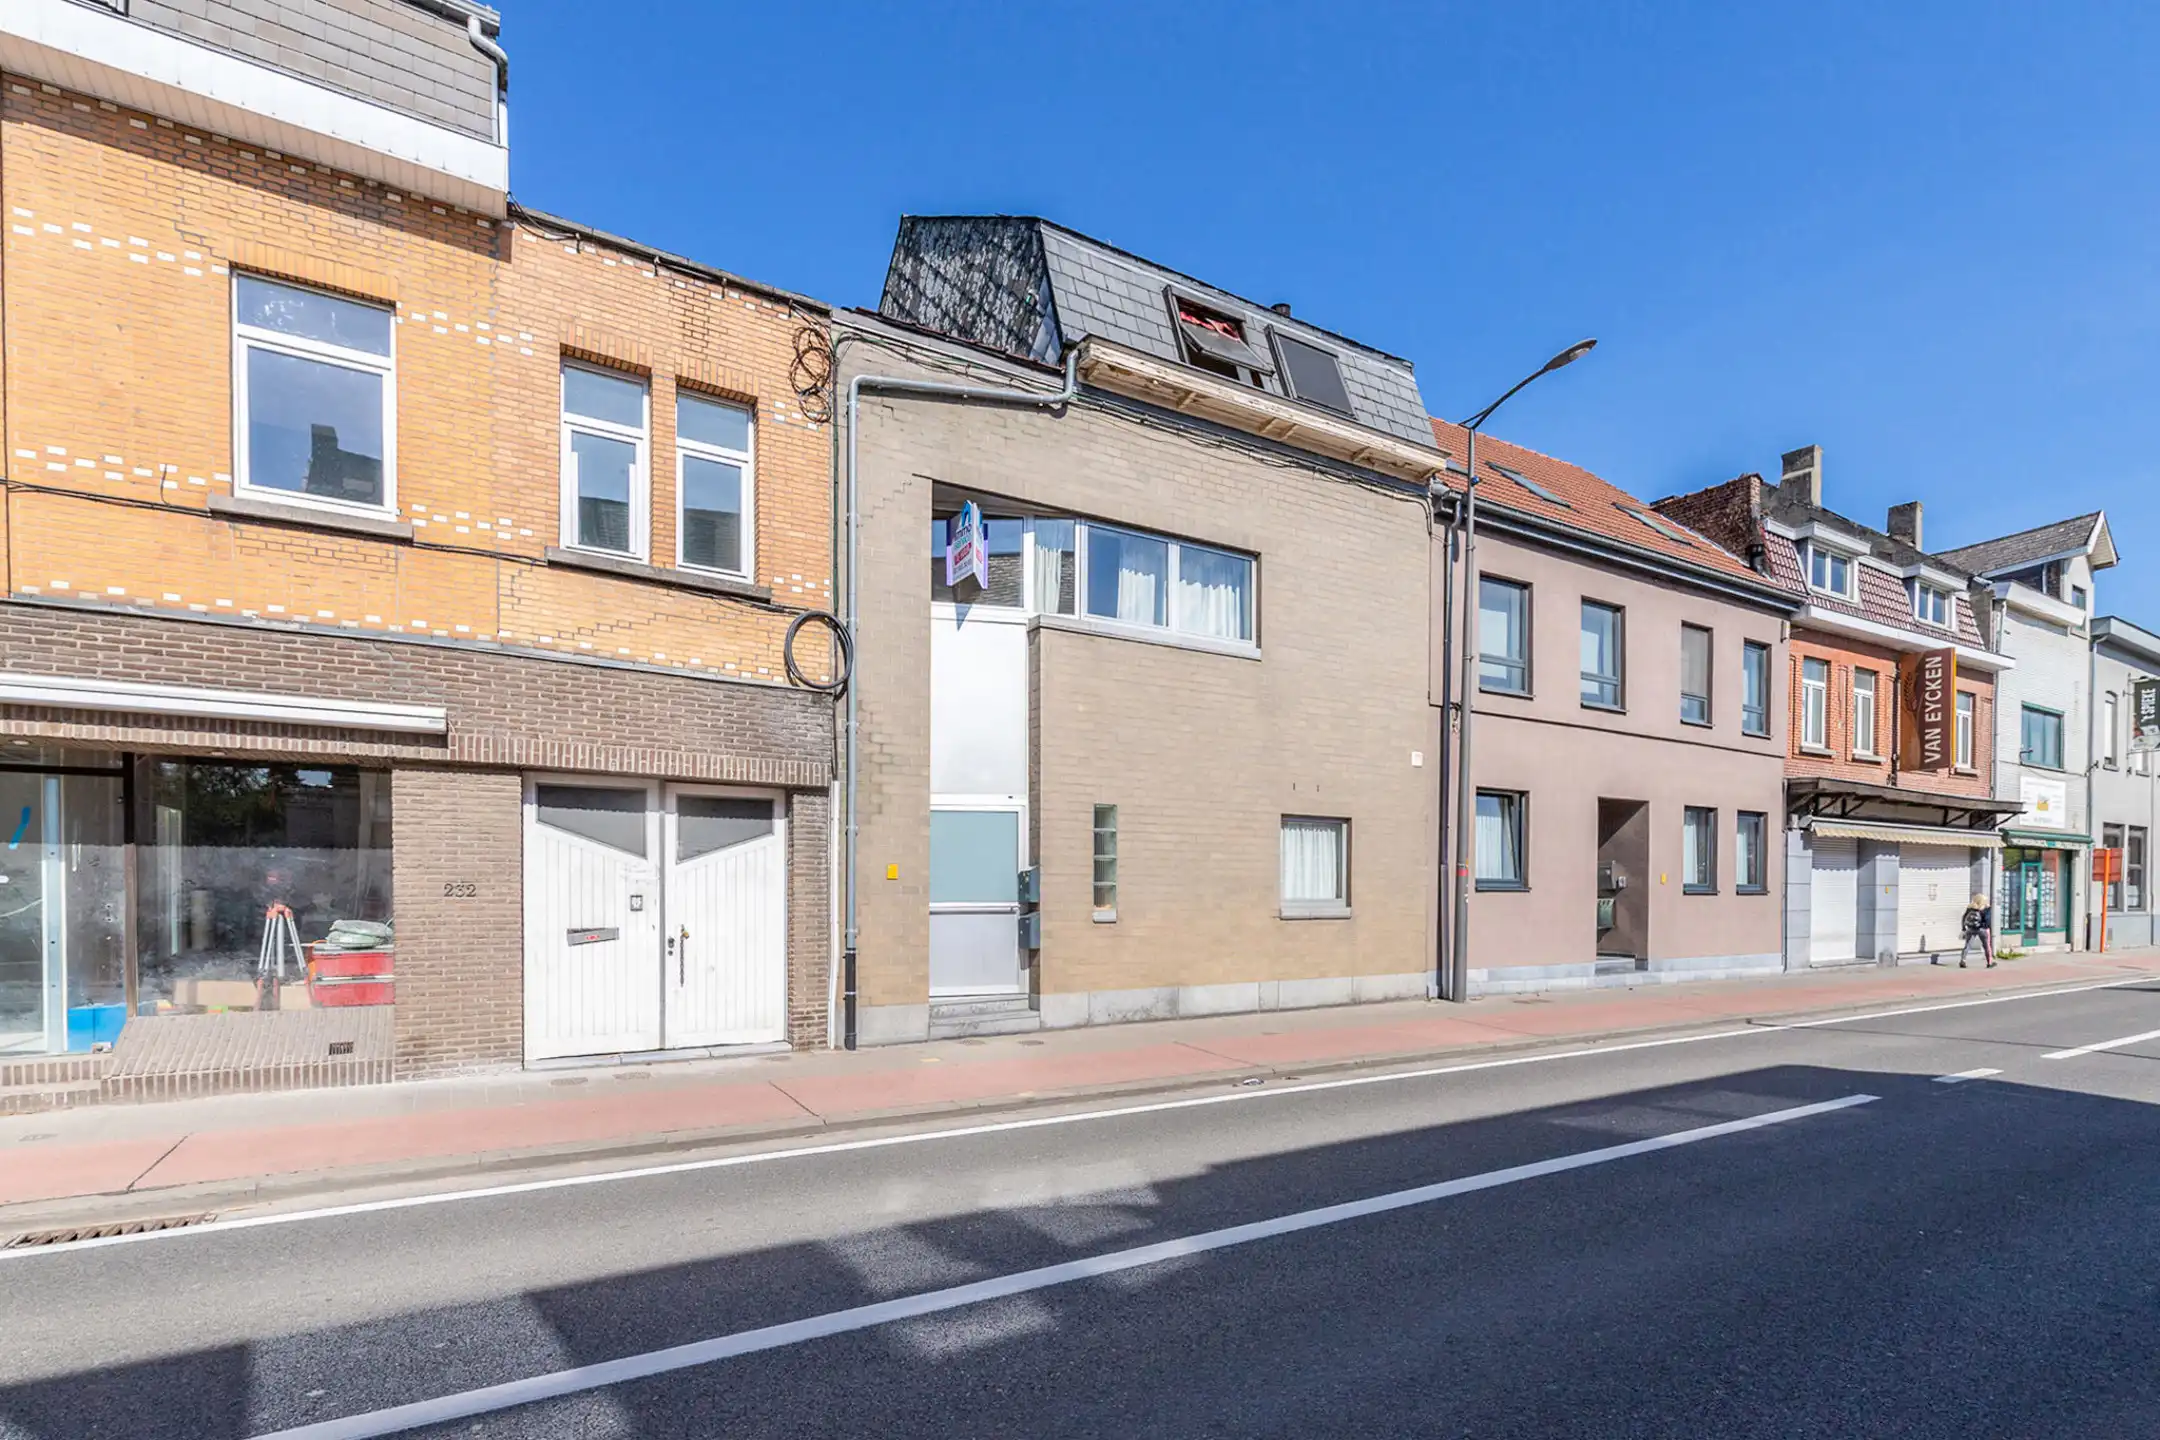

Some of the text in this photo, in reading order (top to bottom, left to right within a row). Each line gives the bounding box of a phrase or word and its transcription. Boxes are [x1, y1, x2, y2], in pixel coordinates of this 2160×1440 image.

[1924, 656, 1943, 763] VAN EYCKEN
[443, 883, 477, 898] 232
